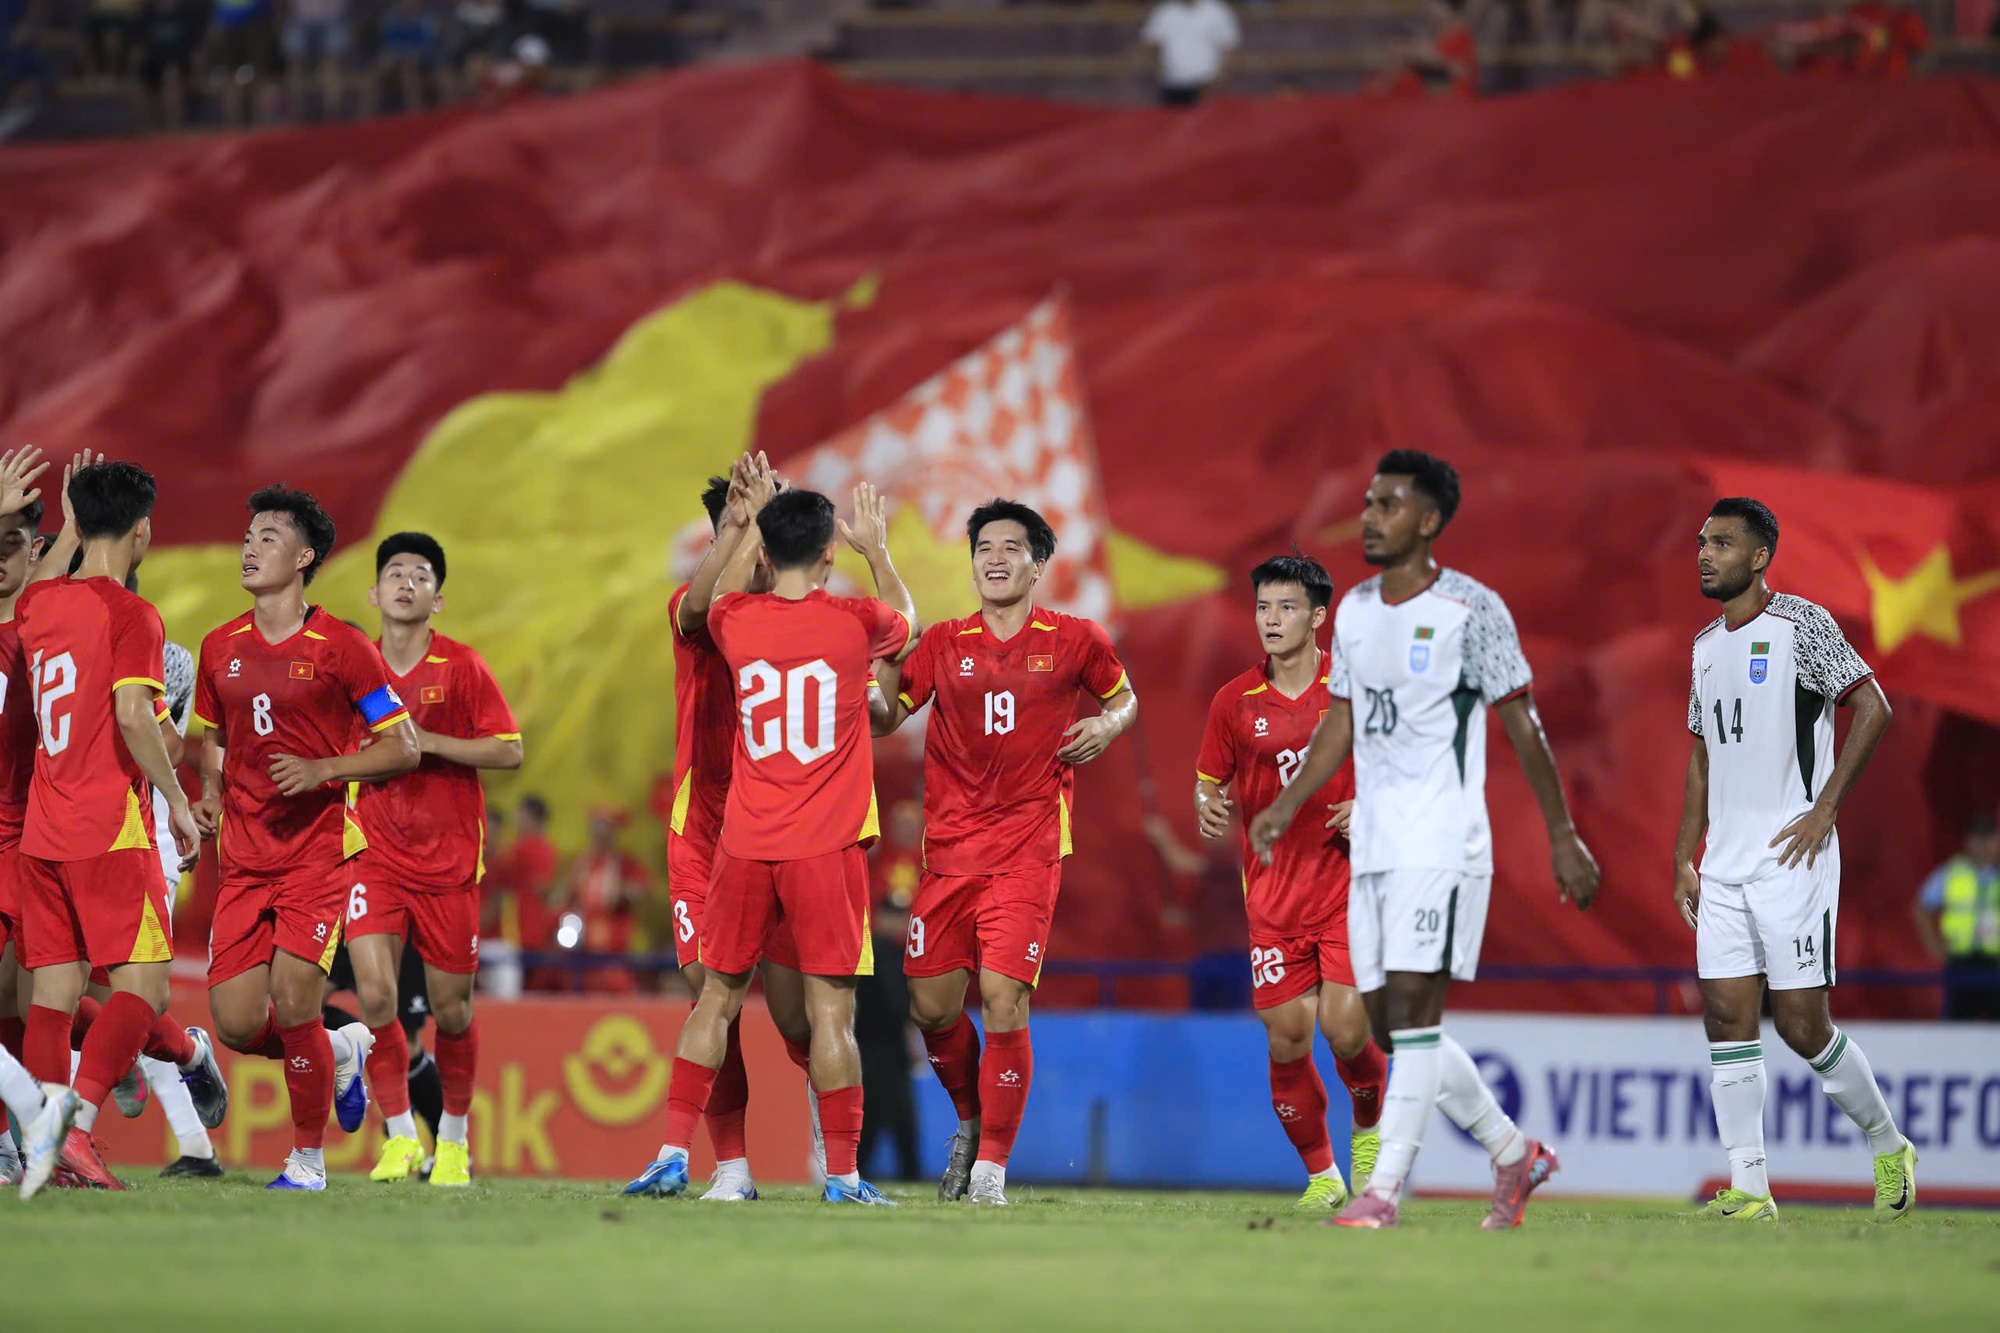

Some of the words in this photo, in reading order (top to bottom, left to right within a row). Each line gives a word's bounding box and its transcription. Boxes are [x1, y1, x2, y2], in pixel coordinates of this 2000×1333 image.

[252, 692, 274, 737] 8
[738, 658, 838, 766] 20
[984, 690, 1015, 737] 19
[1364, 687, 1398, 736] 20
[1713, 697, 1744, 744] 14
[345, 882, 368, 926] 6
[673, 899, 696, 944] 3
[1414, 908, 1440, 932] 20
[1792, 935, 1815, 958] 14
